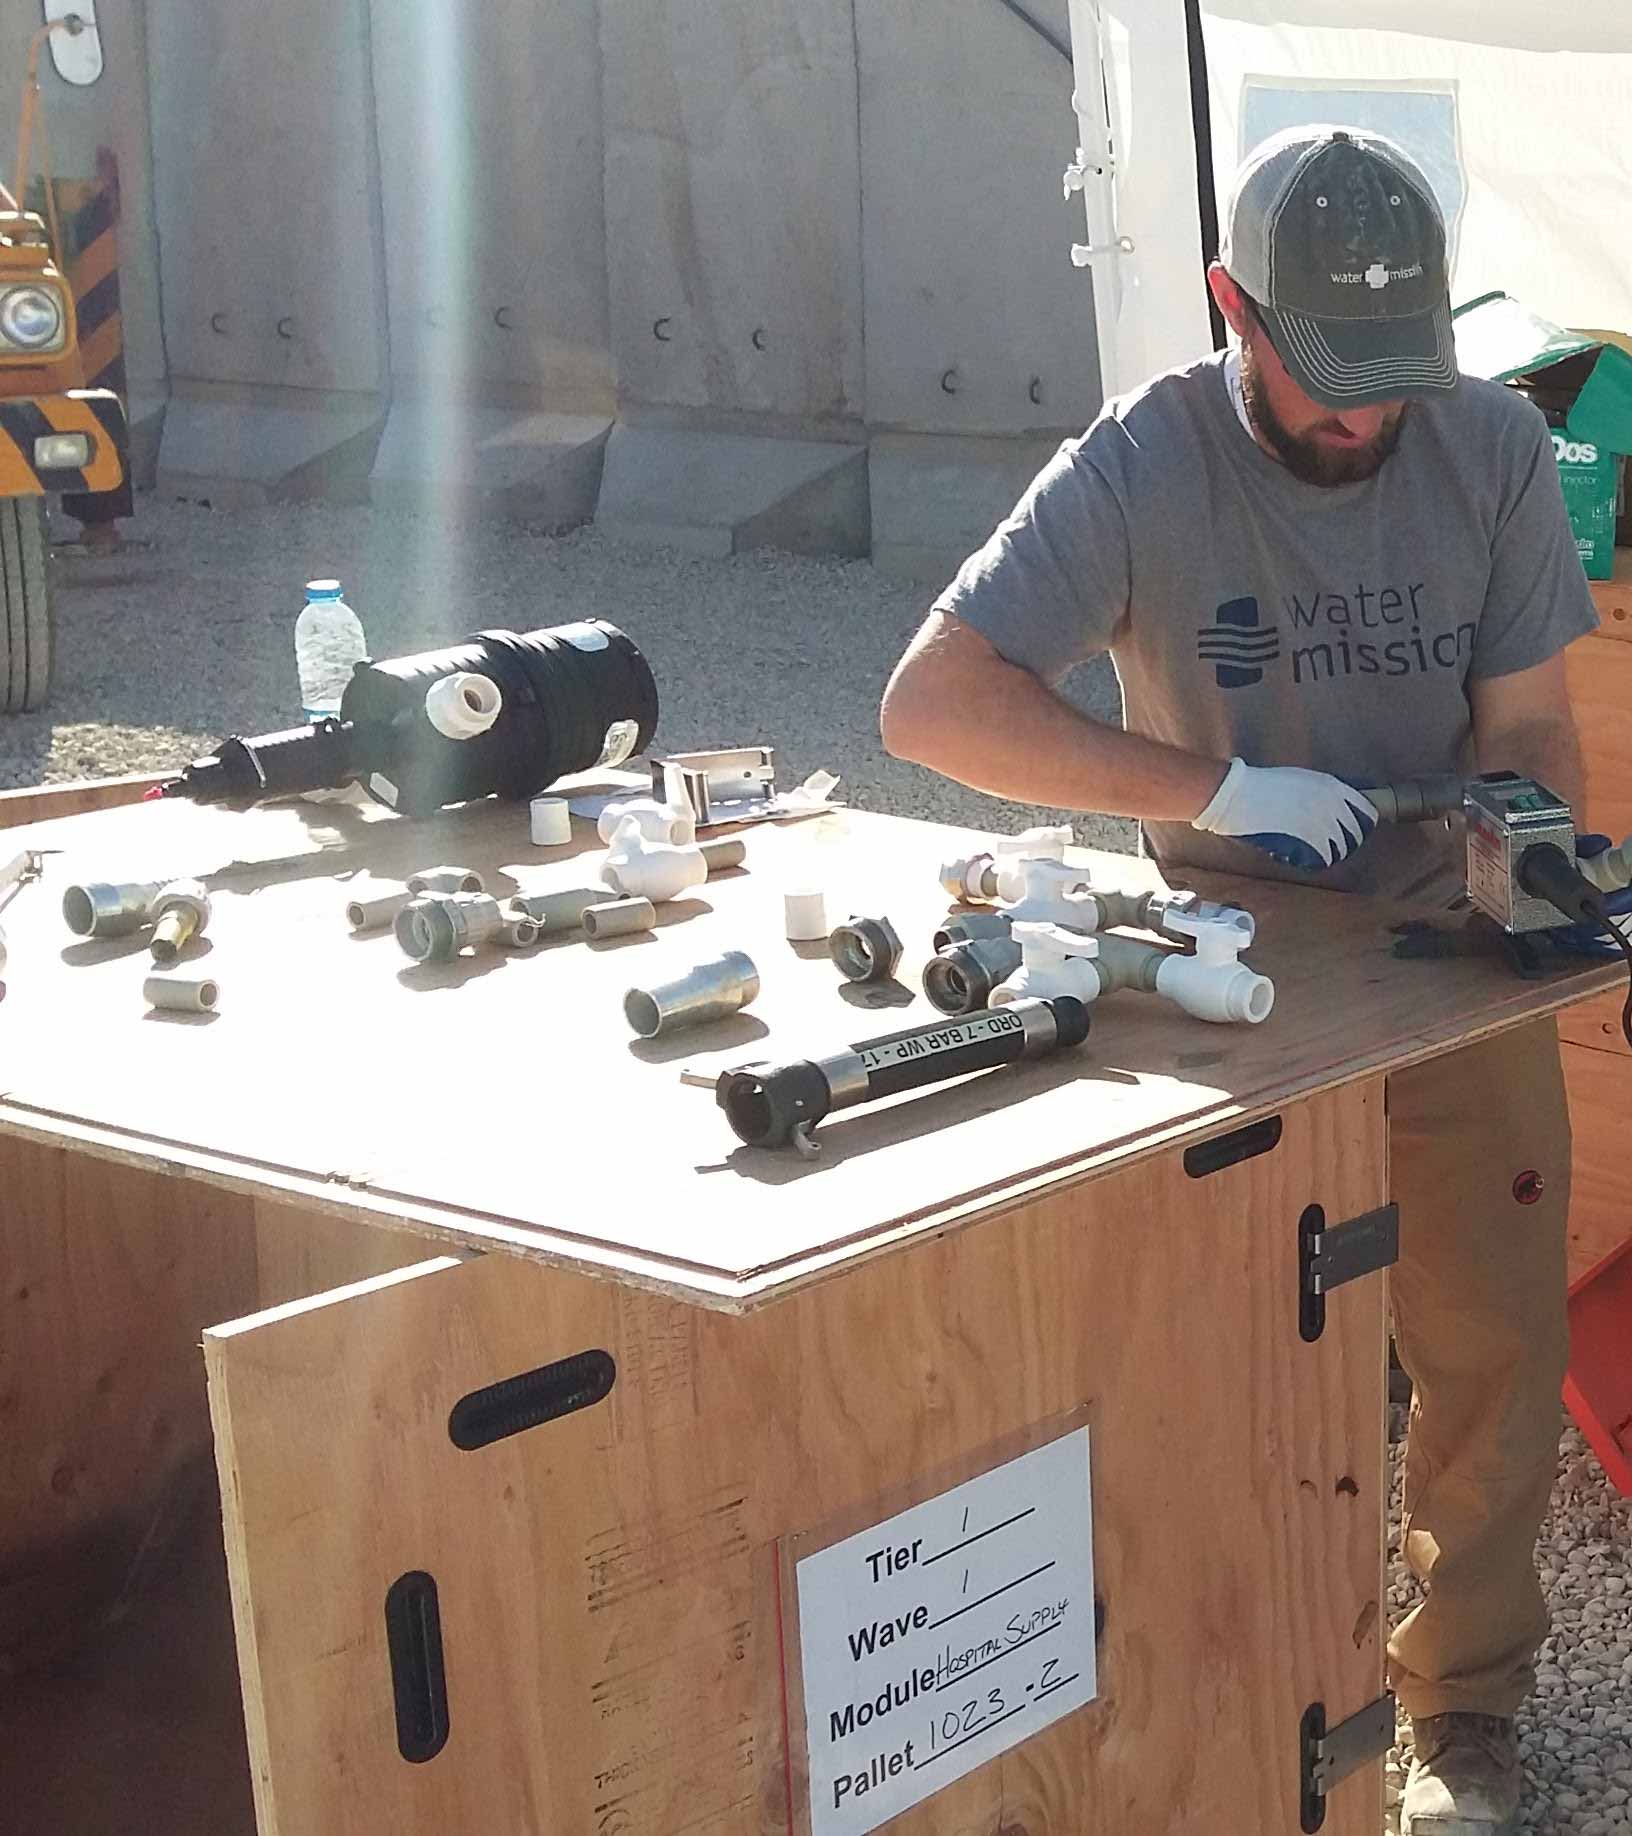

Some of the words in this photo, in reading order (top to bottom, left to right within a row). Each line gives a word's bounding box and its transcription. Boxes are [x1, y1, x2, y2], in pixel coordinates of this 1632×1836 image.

[1330, 272, 1363, 283] water
[1284, 583, 1424, 629] water
[1293, 625, 1476, 683] mission
[897, 1039, 926, 1058] WP
[929, 1029, 964, 1049] BAR
[967, 1025, 978, 1039] 7
[865, 1538, 922, 1583] Tier
[848, 1605, 928, 1661] Wave
[830, 1668, 936, 1742] Module
[833, 1740, 914, 1808] Pallet
